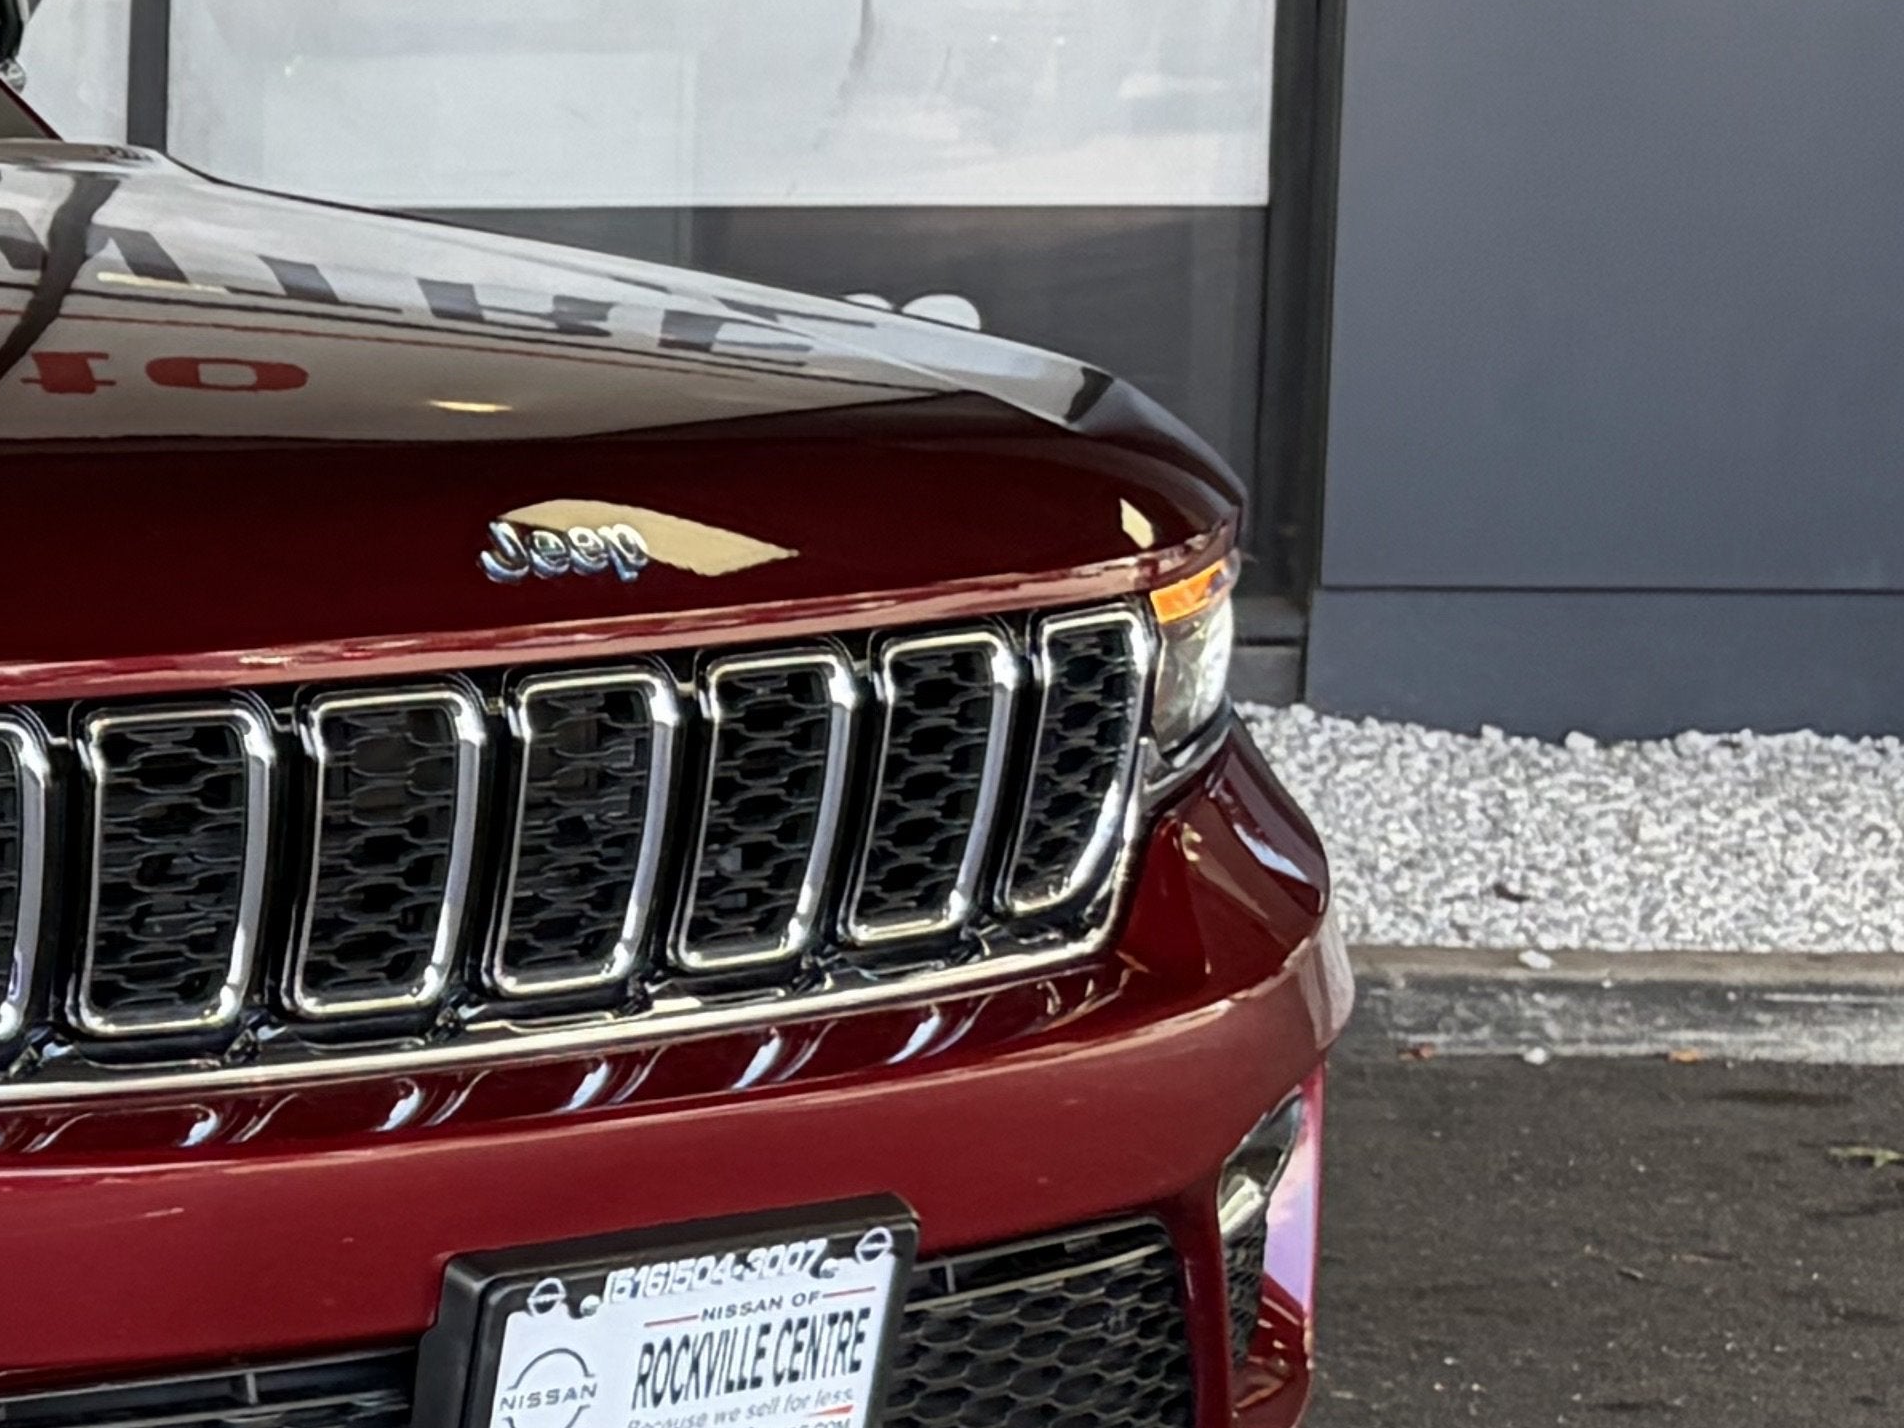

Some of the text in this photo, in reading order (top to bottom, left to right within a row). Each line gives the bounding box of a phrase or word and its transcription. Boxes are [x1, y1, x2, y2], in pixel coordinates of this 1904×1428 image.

[479, 521, 648, 583] Jeep
[700, 1289, 821, 1322] NISSAN OF
[631, 1307, 871, 1410] ROCKVILLE CENTRE
[499, 1382, 597, 1411] NISSAN
[712, 1408, 740, 1426] we
[744, 1397, 780, 1421] sell
[784, 1392, 811, 1416] for
